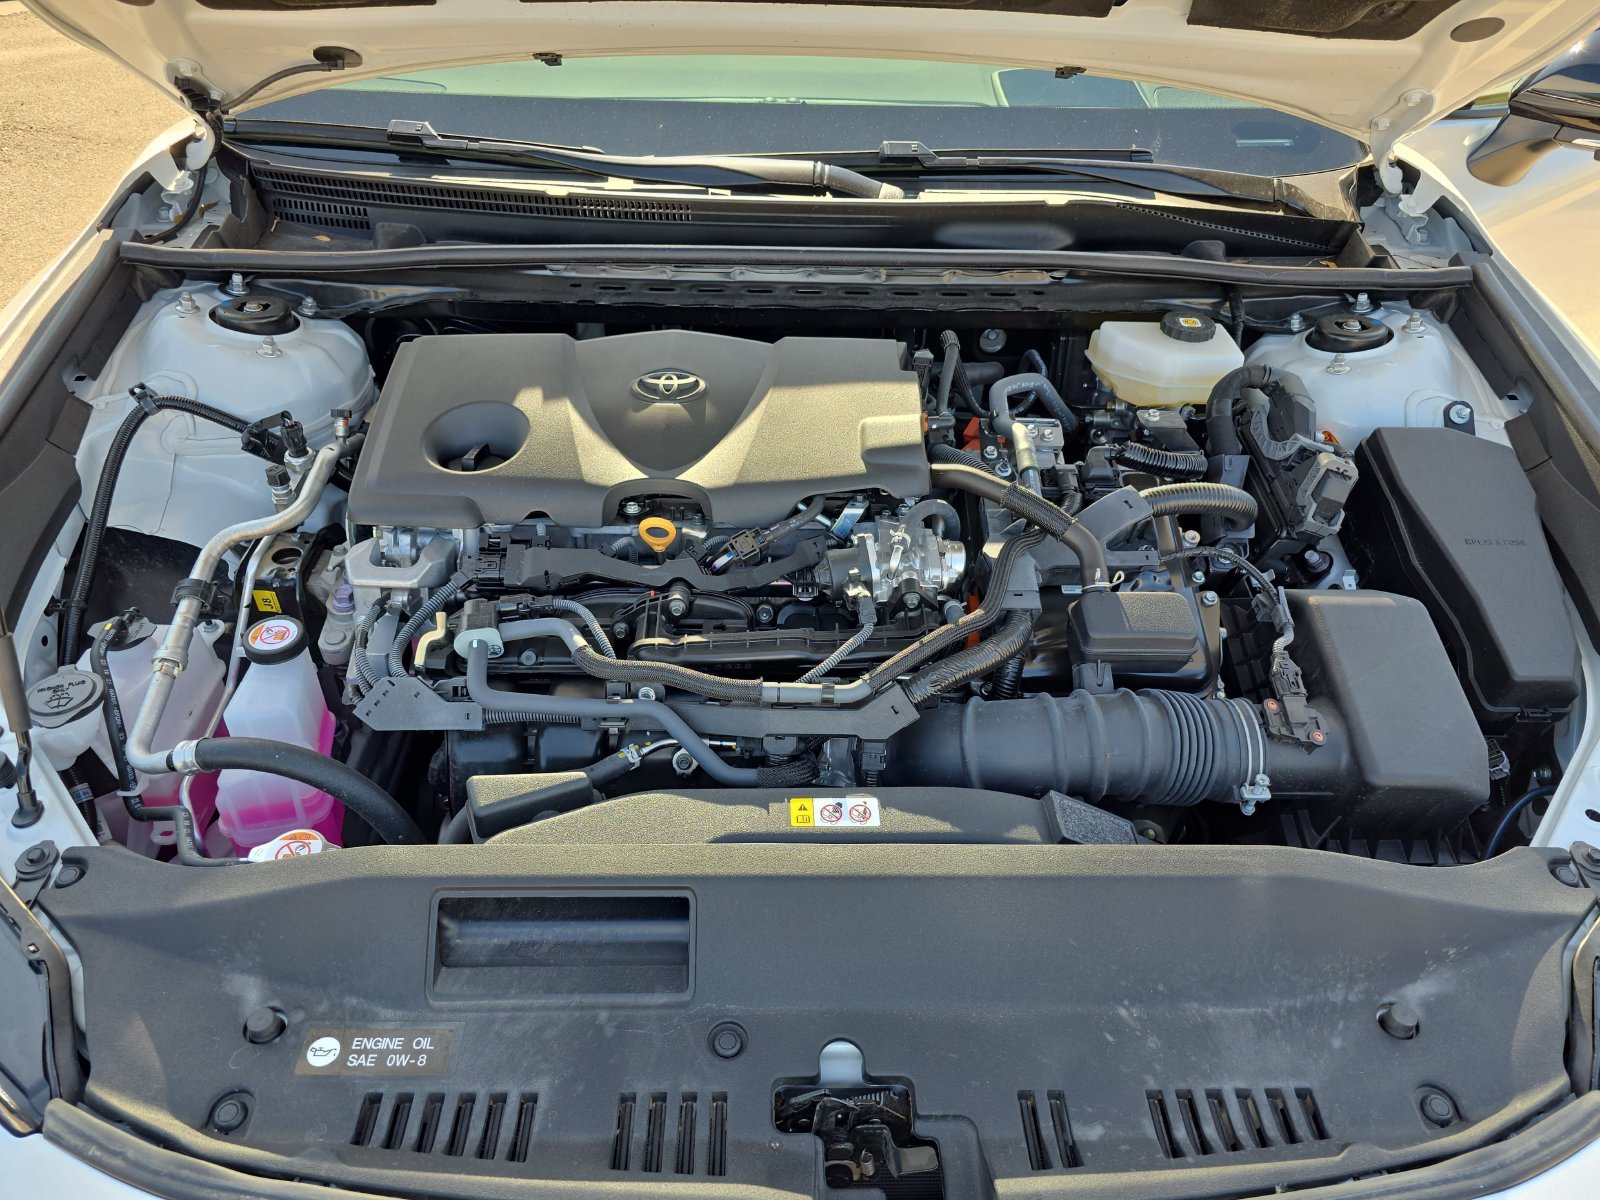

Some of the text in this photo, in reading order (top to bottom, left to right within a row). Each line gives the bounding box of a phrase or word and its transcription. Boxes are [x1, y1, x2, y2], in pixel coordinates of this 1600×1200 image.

[351, 1037, 434, 1050] ENGINE OIL
[347, 1054, 427, 1067] SAE 0W-8
